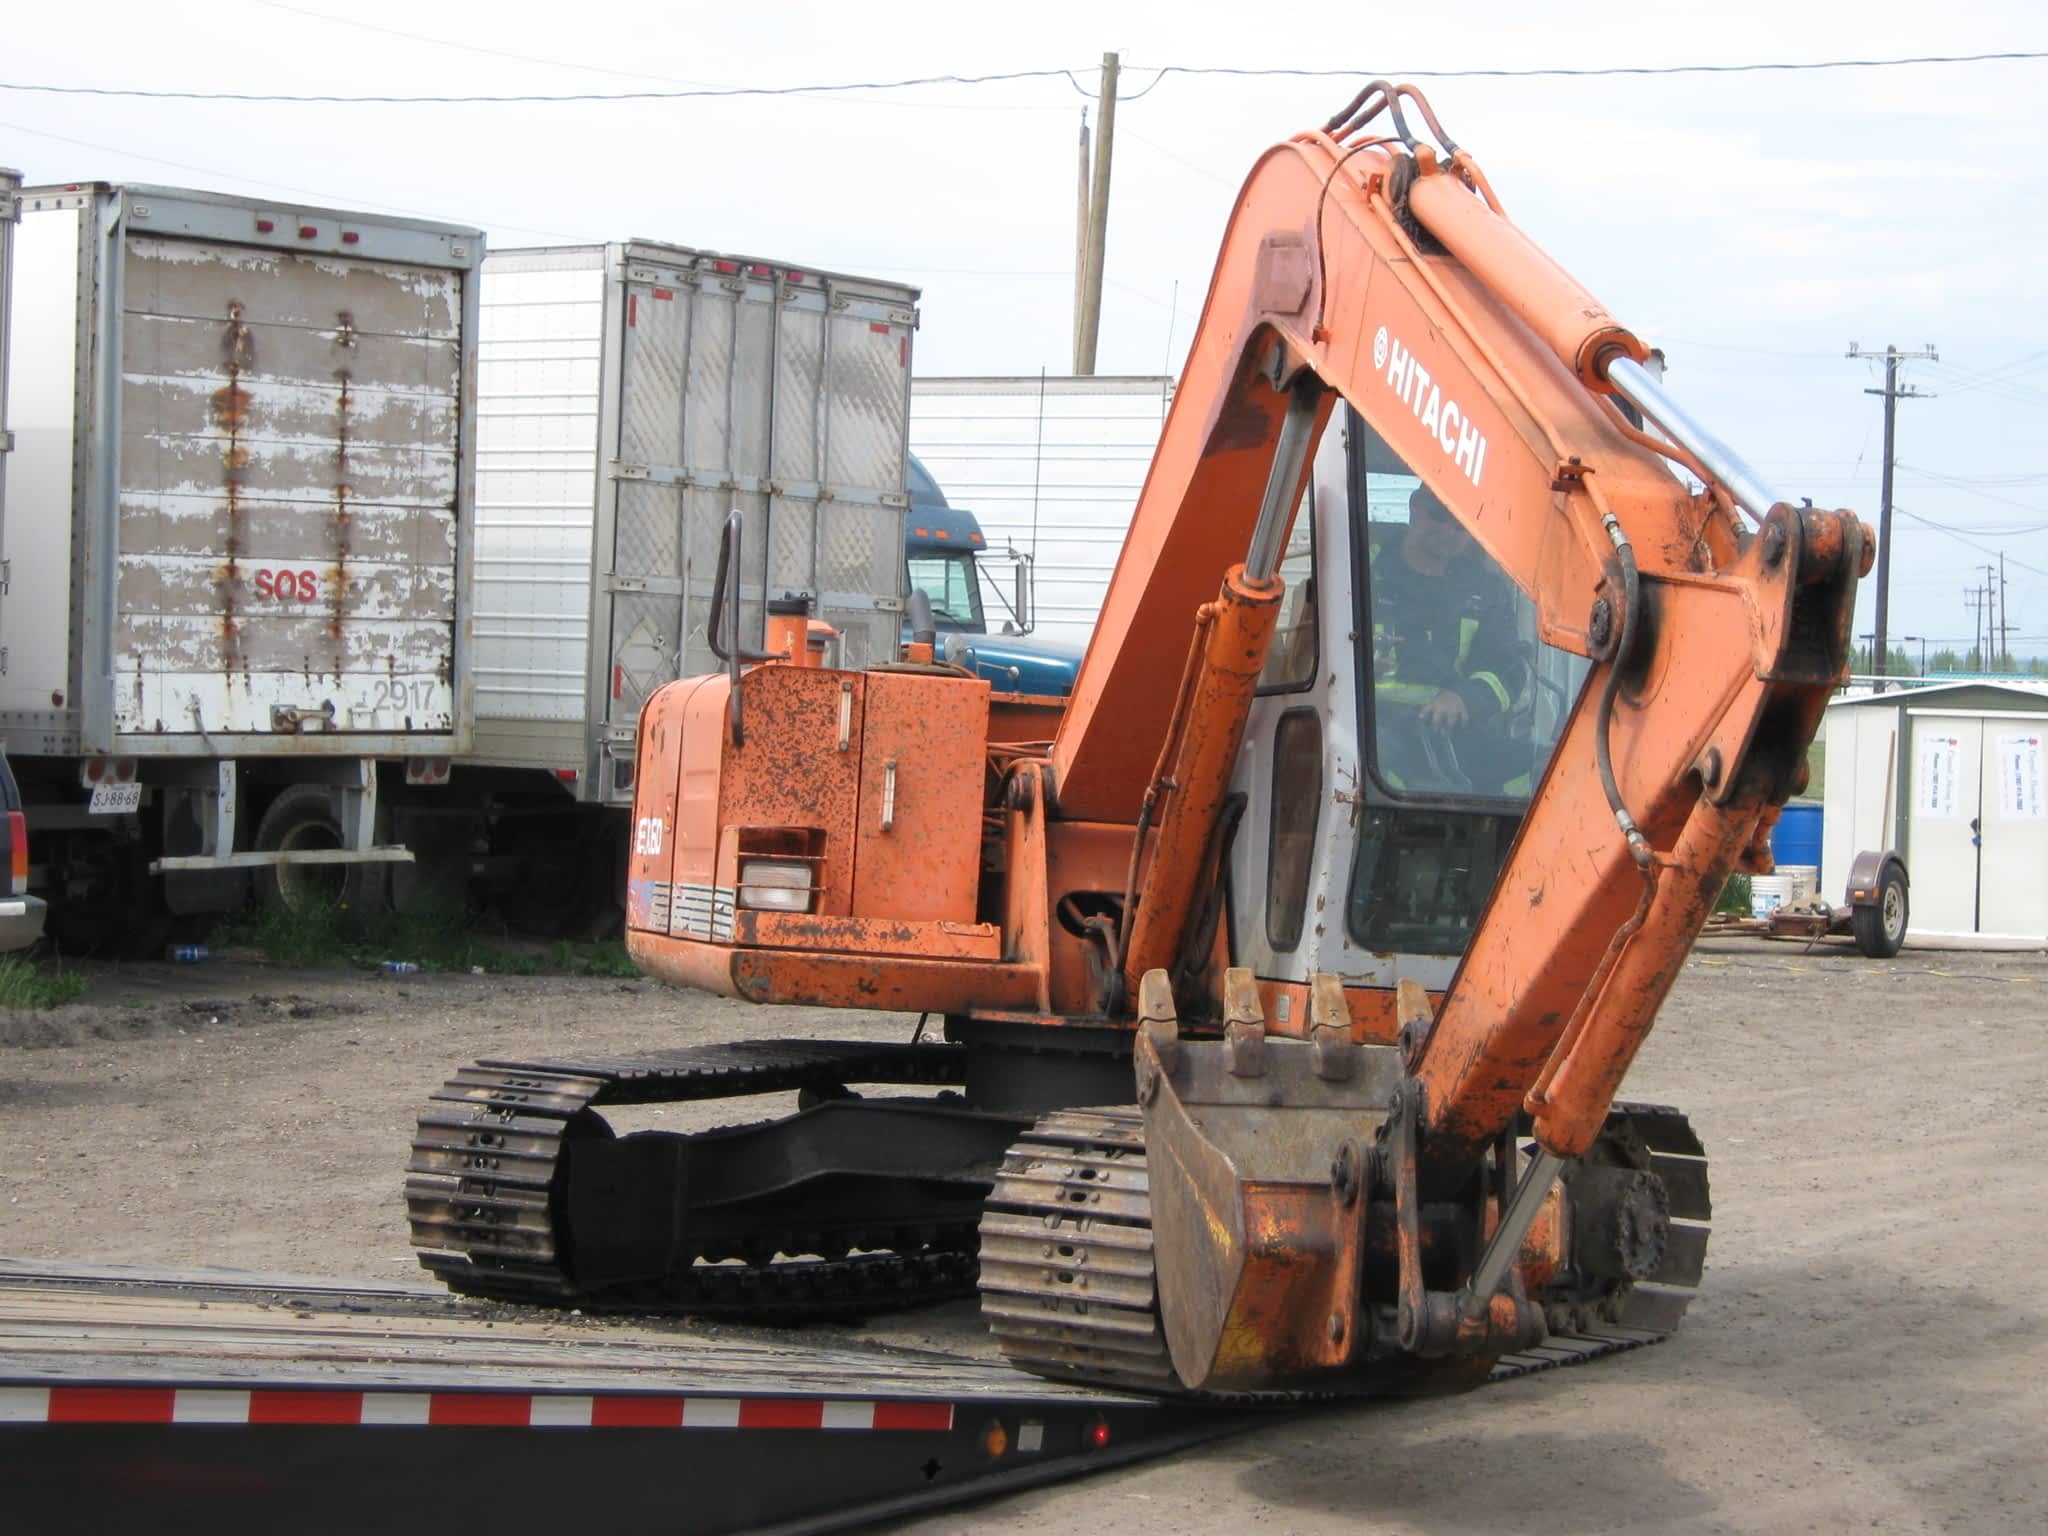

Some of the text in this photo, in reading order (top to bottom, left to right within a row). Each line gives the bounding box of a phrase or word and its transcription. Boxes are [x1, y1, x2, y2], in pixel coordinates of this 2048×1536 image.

[1387, 338, 1486, 488] HITACHI
[255, 568, 317, 603] SOS
[374, 680, 435, 711] 2917
